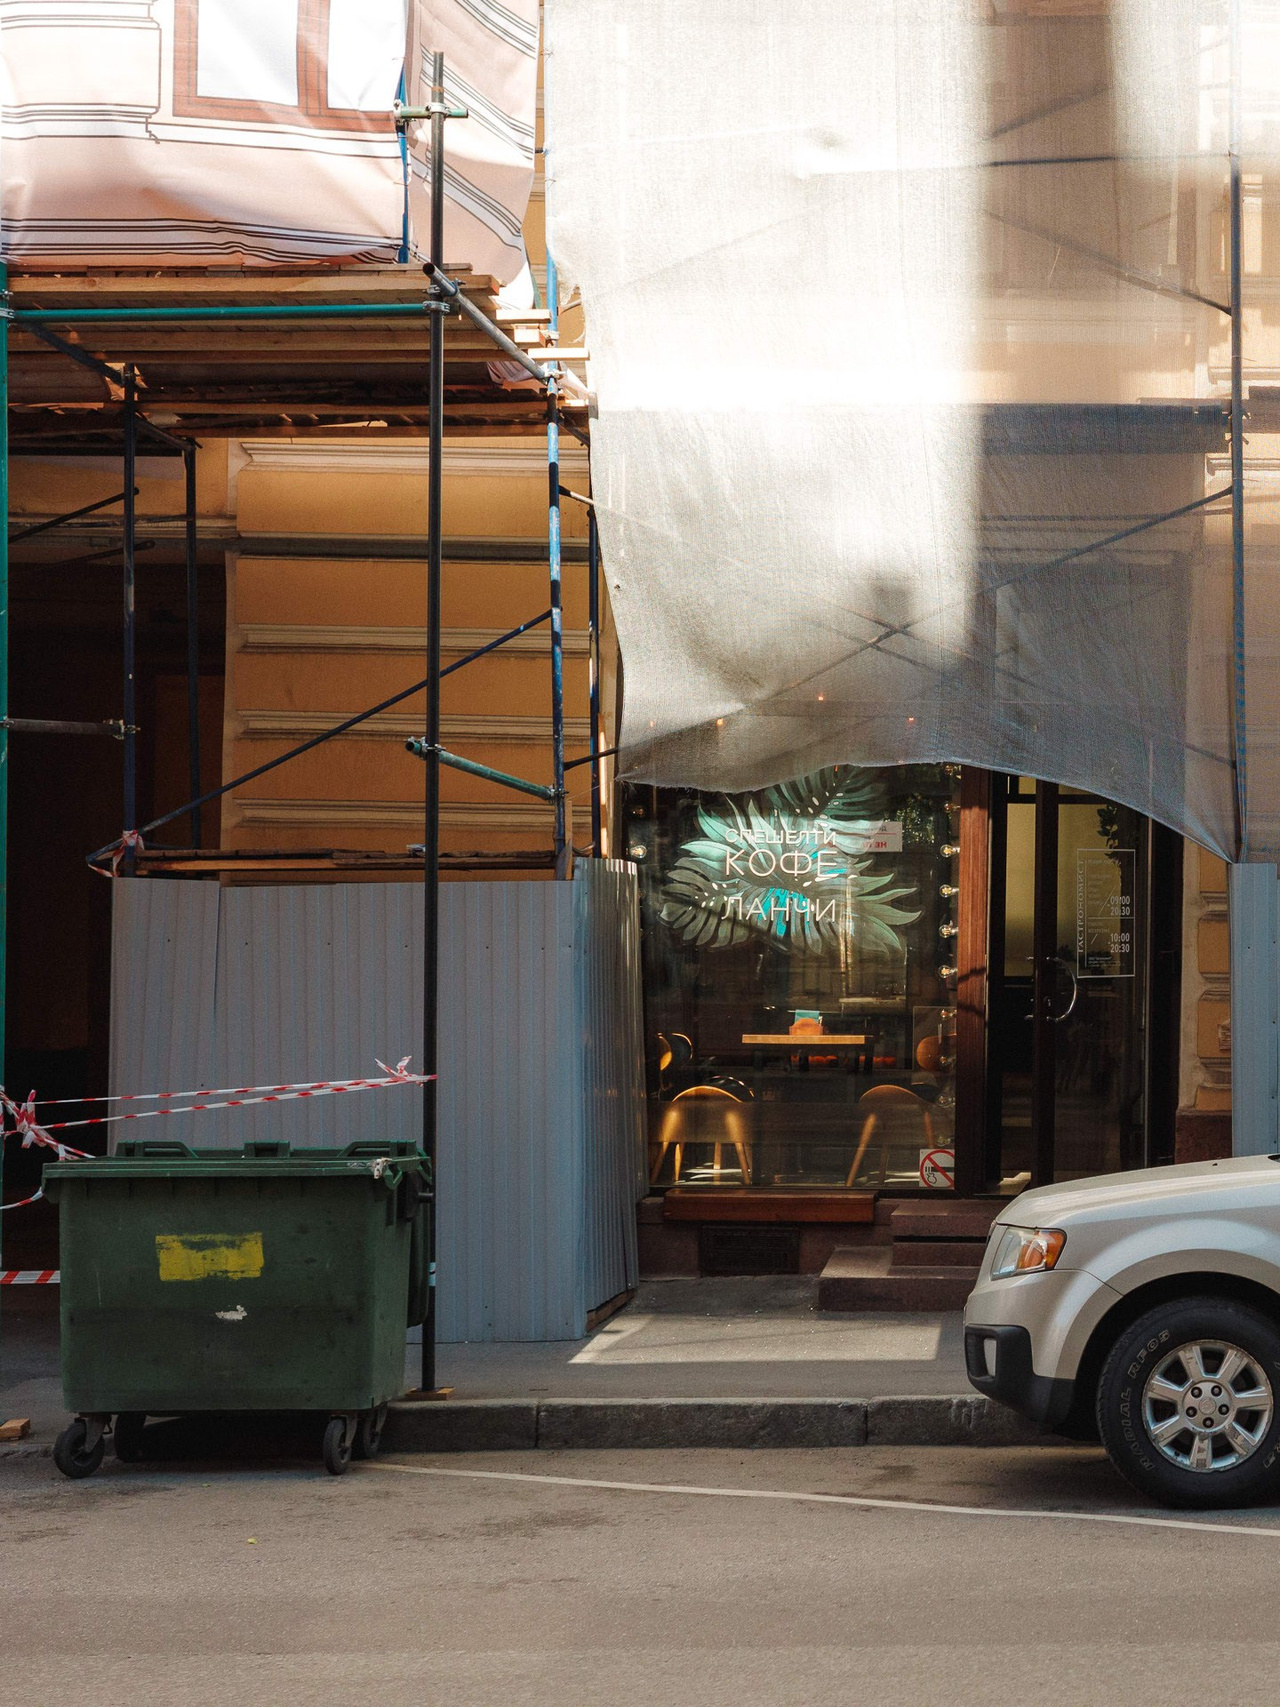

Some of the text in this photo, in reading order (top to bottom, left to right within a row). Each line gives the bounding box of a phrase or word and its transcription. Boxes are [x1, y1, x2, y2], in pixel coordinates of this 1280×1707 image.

[725, 828, 836, 845] СПЕШЕЛТИ
[725, 849, 838, 877] КОФЕ
[1110, 896, 1130, 905] 09:00
[721, 896, 836, 922] ЛАНЧИ
[1110, 906, 1130, 916] 20:30
[1110, 933, 1130, 942] 10:00
[1110, 943, 1130, 953] 20:30
[1120, 1387, 1154, 1471] RADIAL
